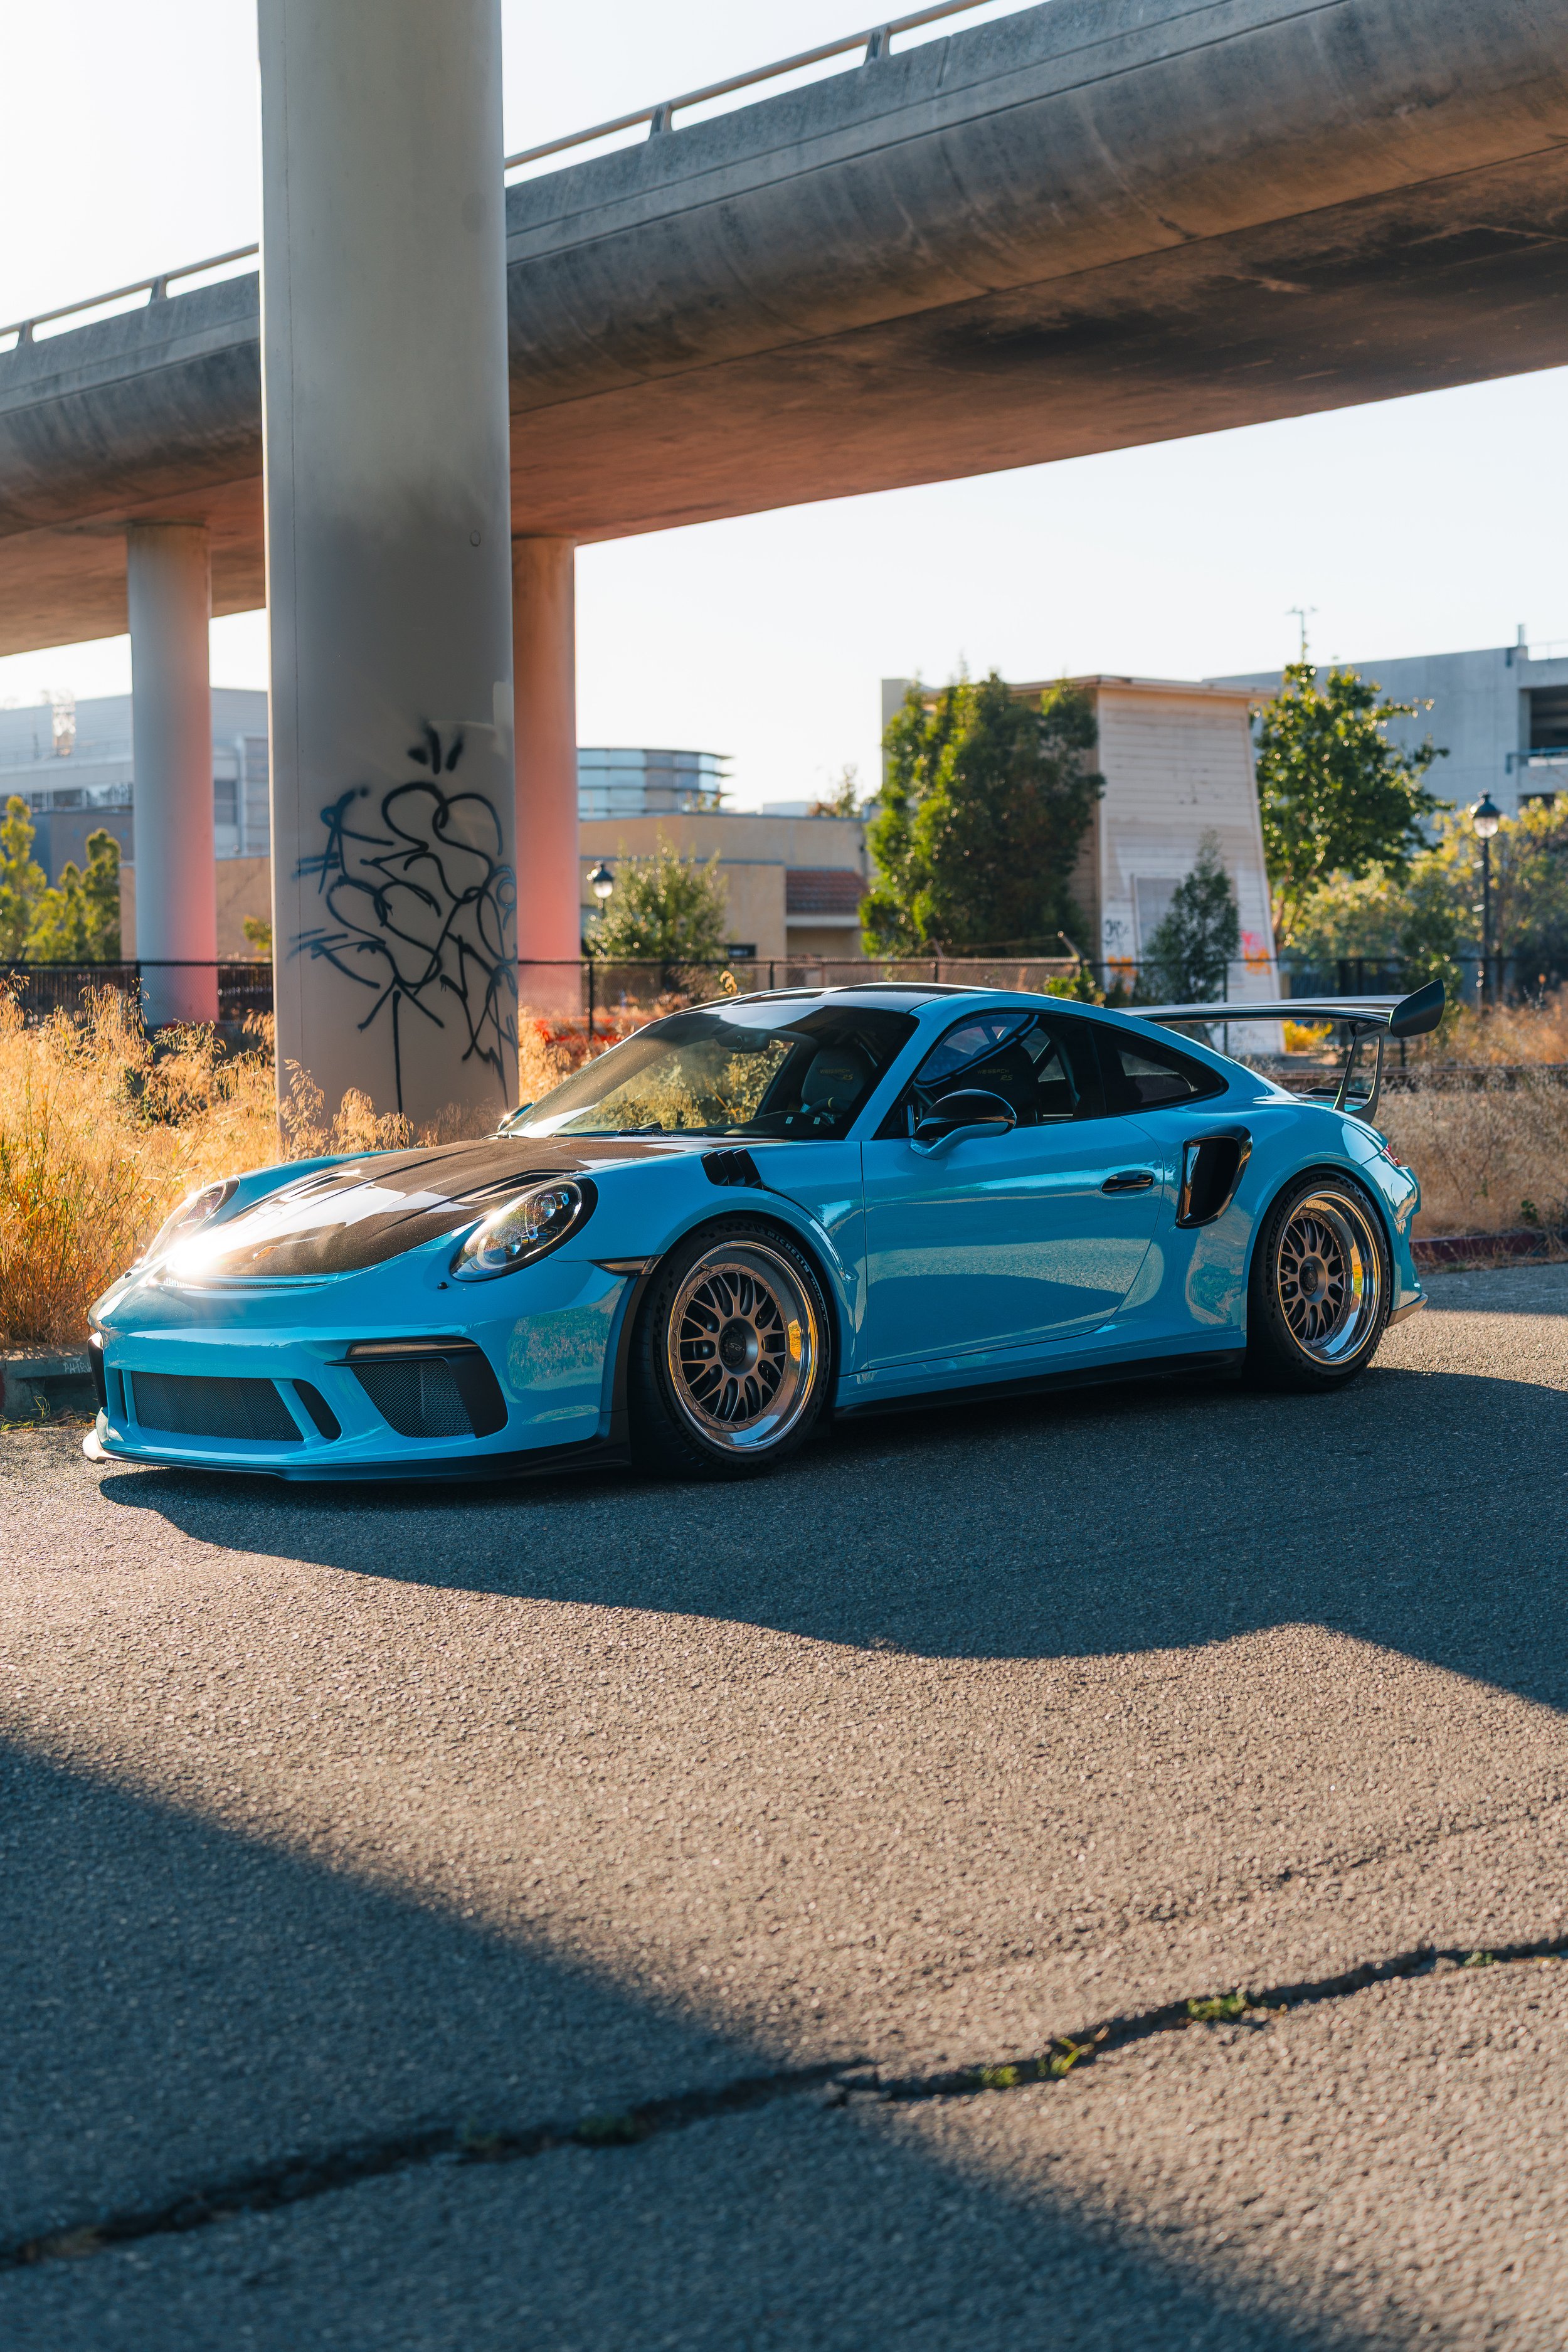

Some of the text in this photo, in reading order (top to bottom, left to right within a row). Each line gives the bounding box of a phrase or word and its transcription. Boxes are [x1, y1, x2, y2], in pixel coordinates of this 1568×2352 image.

[1269, 1190, 1295, 1244] MICHELIN
[767, 1230, 809, 1273] MICHELIN
[729, 1342, 743, 1352] RS
